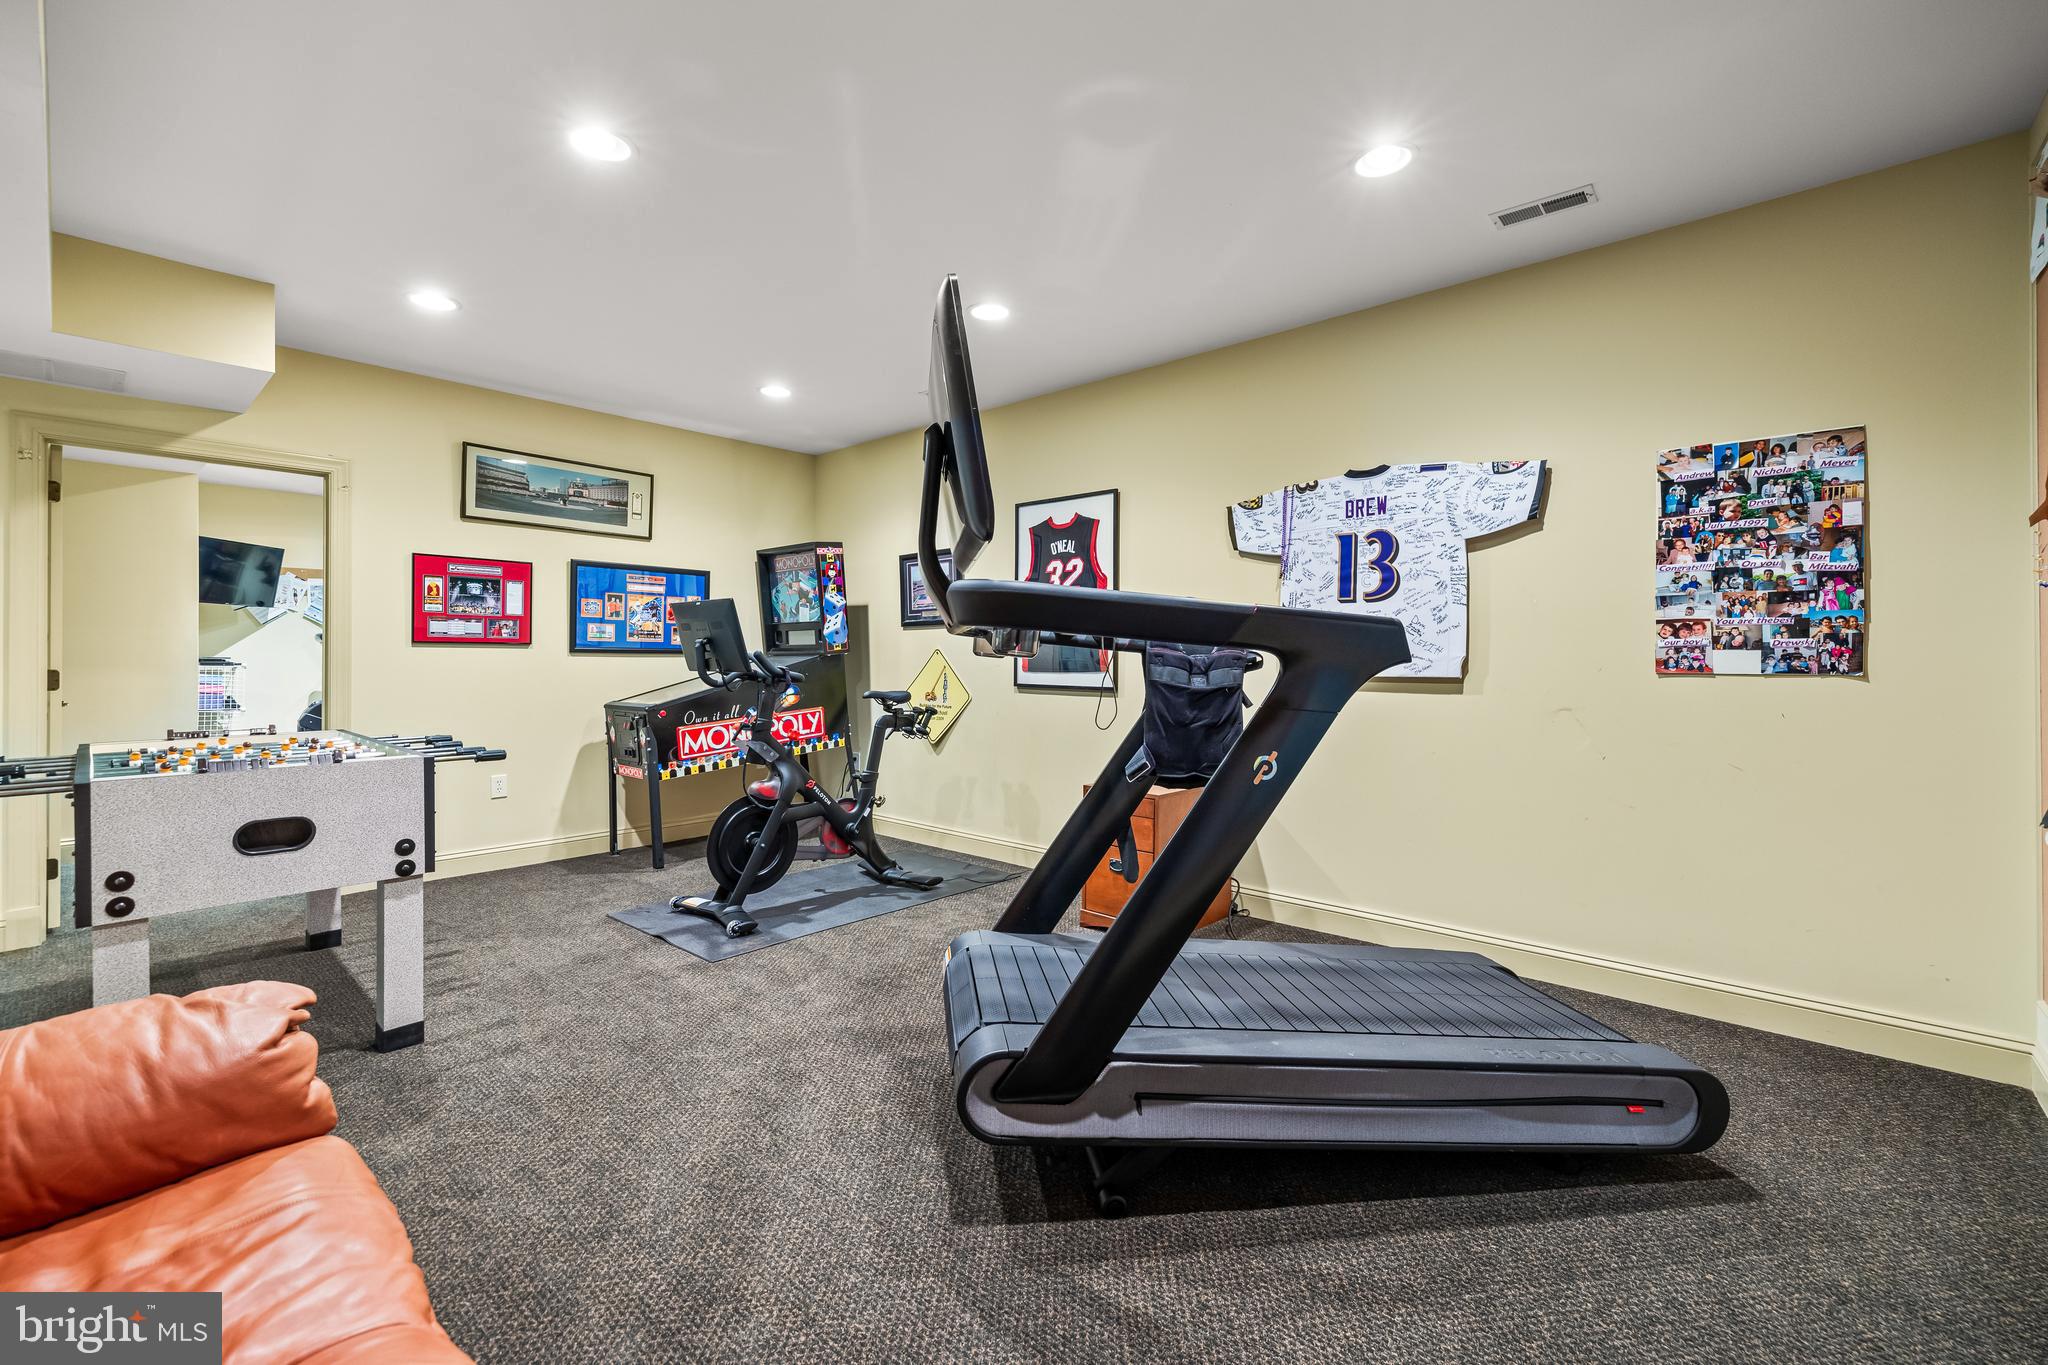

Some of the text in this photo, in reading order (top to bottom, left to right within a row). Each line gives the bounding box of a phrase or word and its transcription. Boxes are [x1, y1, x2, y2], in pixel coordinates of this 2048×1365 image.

[1675, 471, 1714, 481] Andrew
[1752, 466, 1797, 477] Nicholas
[1345, 495, 1388, 519] DREW
[1689, 498, 1777, 515] a.k.a. Drew
[1050, 539, 1076, 555] O'NEAL
[1741, 560, 1757, 568] On
[1808, 562, 1858, 571] Mitzvah!
[1809, 552, 1830, 561] Bar
[1045, 556, 1085, 586] 32
[1334, 529, 1400, 604] 13
[1772, 639, 1814, 647] Drewski
[684, 704, 740, 725] Own it all
[684, 712, 820, 754] MONOLY
[813, 785, 832, 805] PELOTON
